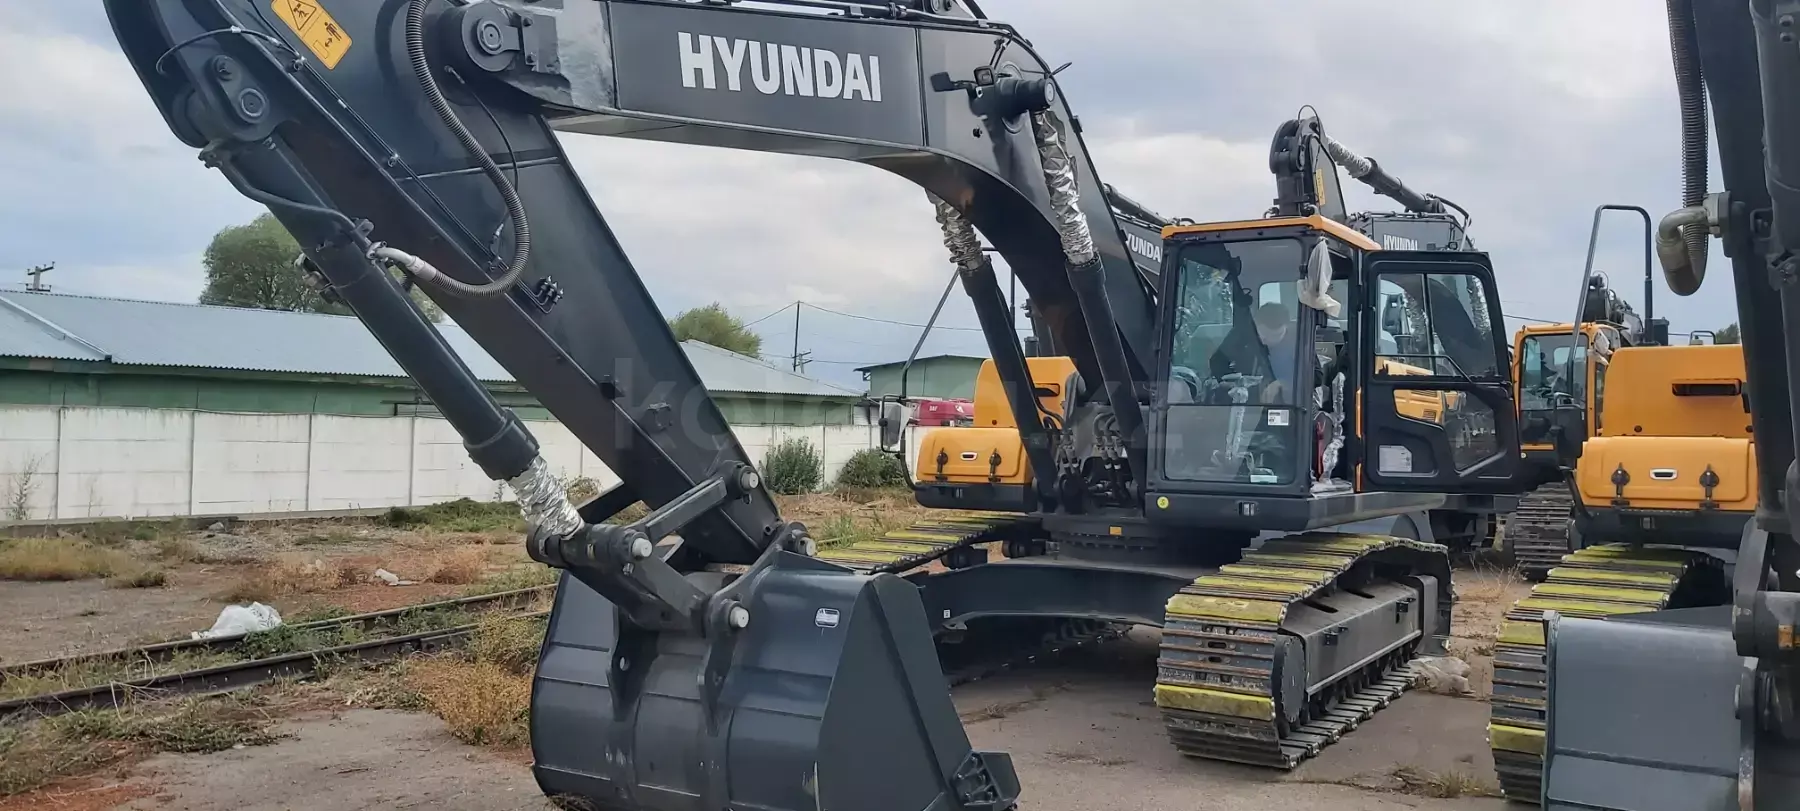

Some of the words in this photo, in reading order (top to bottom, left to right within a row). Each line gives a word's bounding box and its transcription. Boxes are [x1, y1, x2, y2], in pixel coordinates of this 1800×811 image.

[677, 31, 882, 102] HYUNDAI
[1125, 233, 1162, 263] YUNDA
[1383, 234, 1418, 251] HYUNDAI
